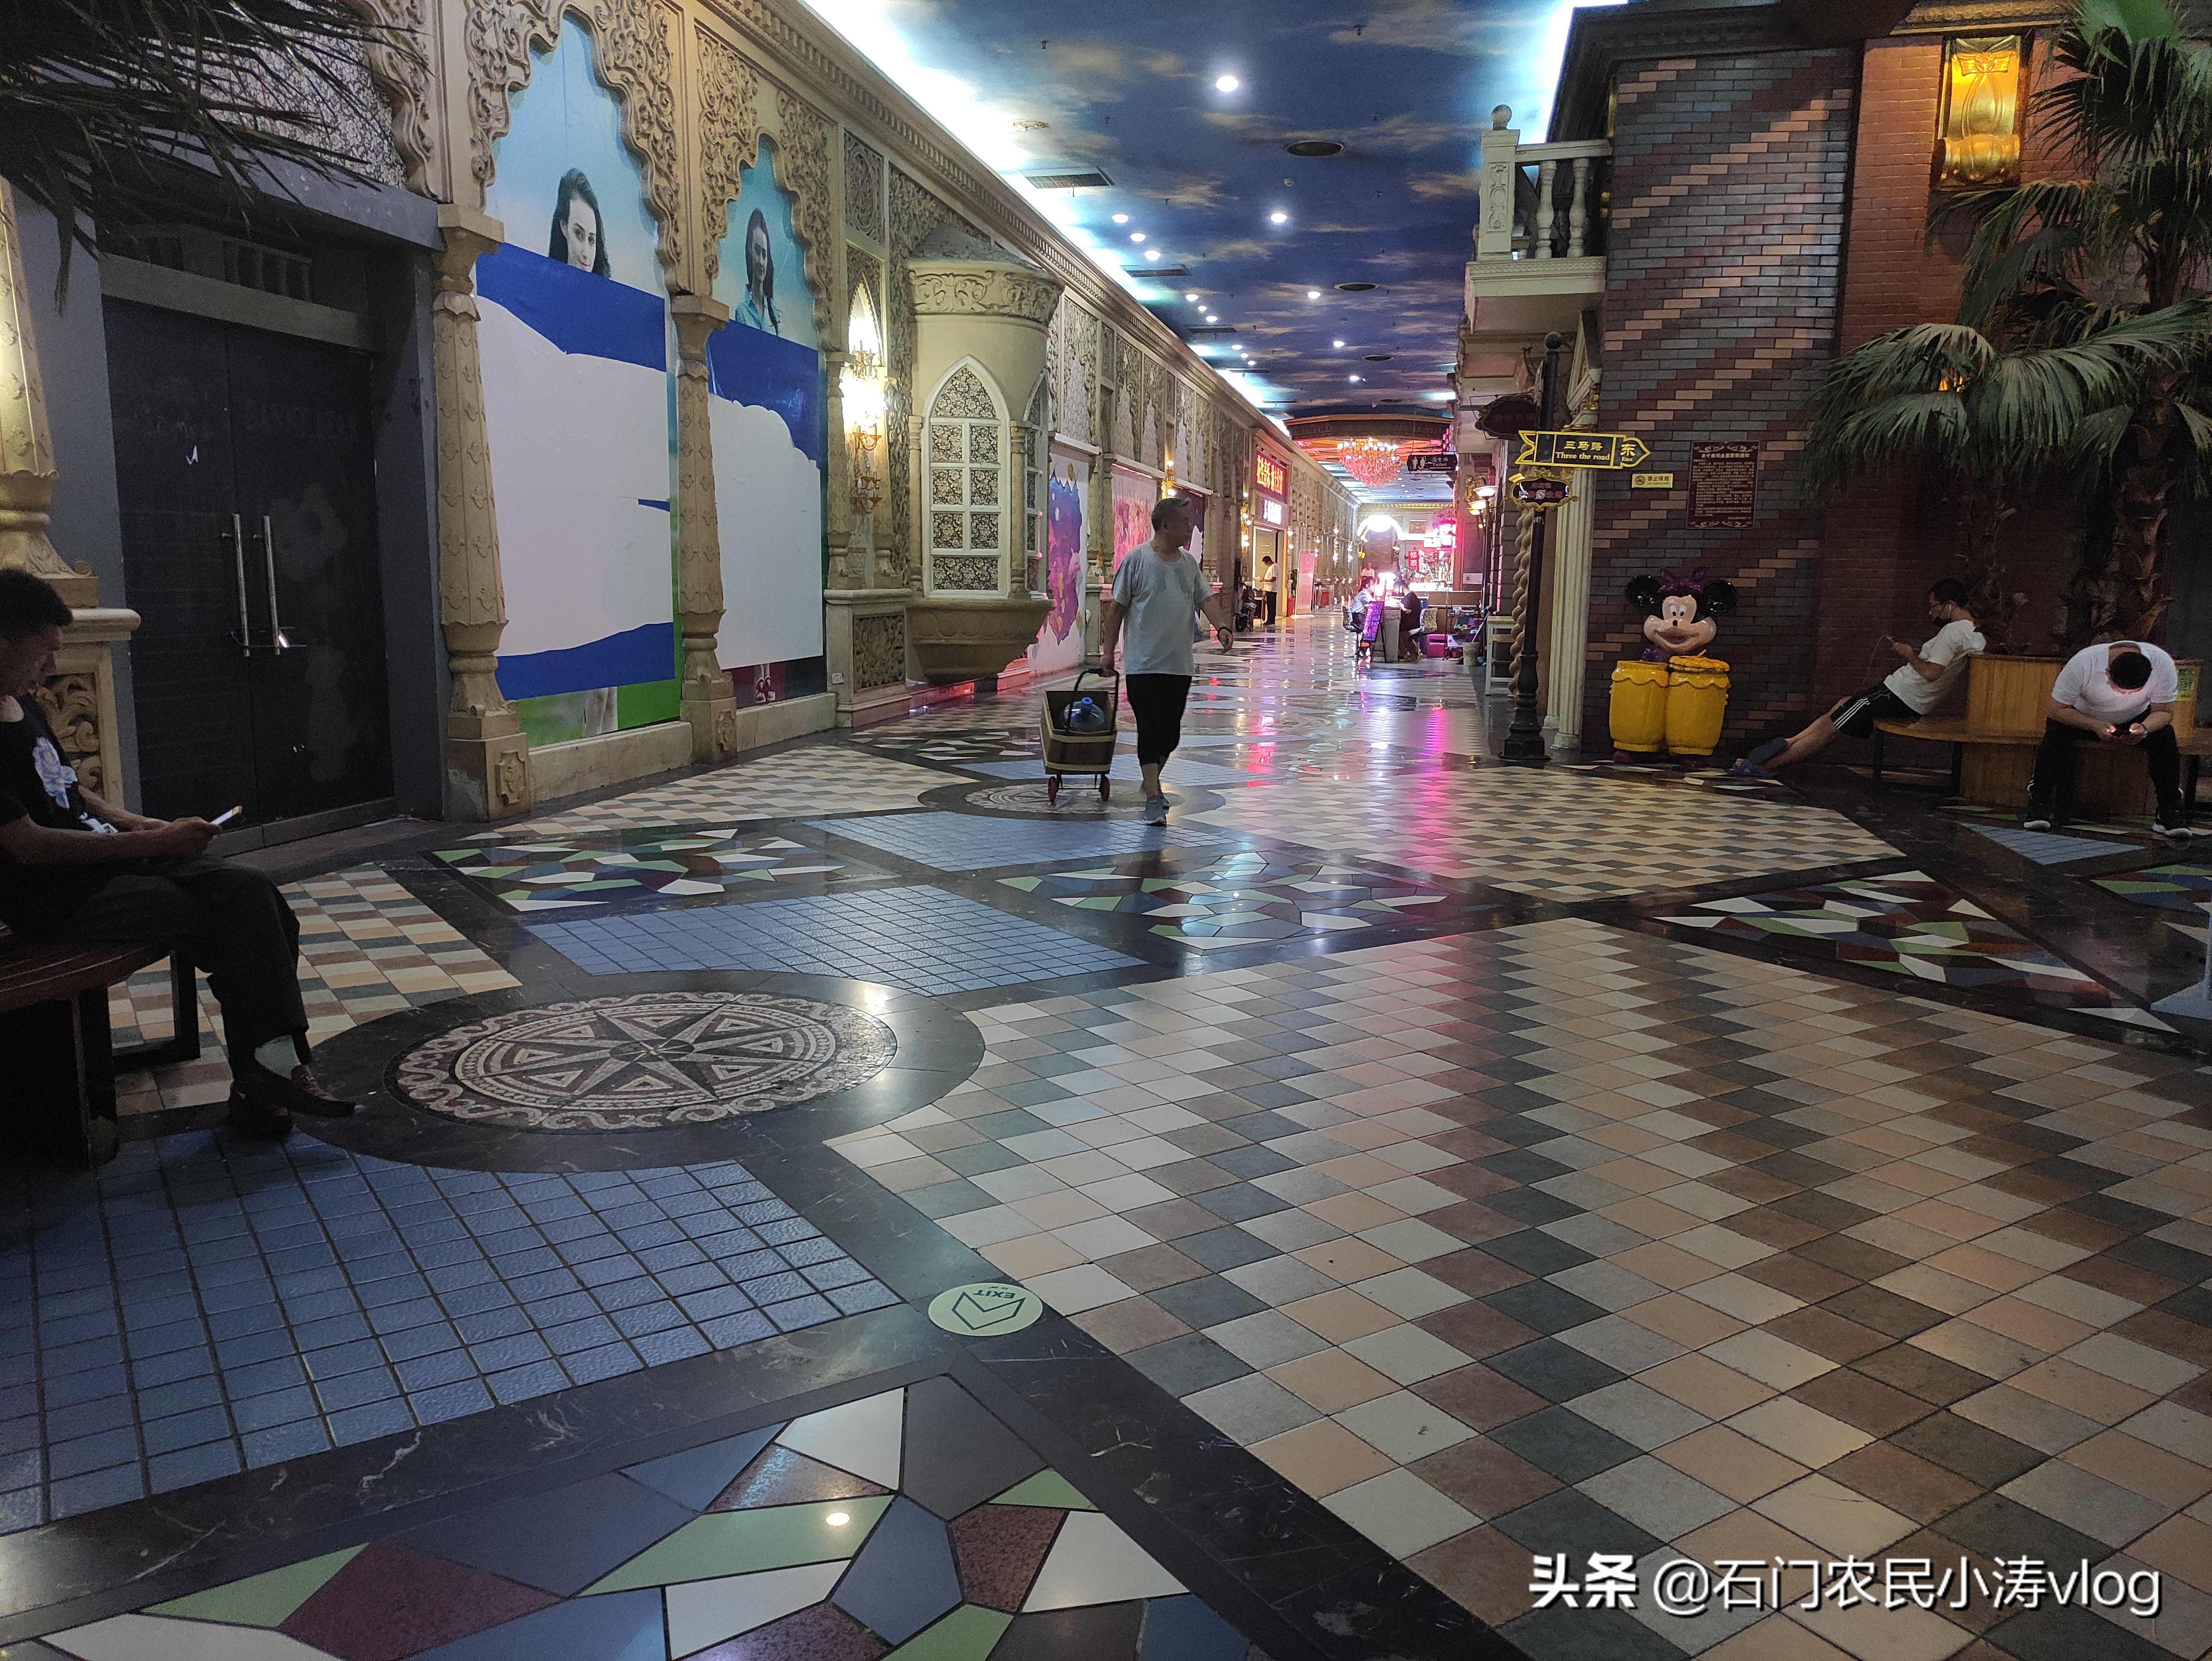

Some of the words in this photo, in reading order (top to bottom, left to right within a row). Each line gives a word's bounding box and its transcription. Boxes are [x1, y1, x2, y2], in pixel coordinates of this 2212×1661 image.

[1564, 441, 1603, 451] 三马路
[1620, 443, 1636, 456] 东
[973, 1290, 1016, 1299] EXIT
